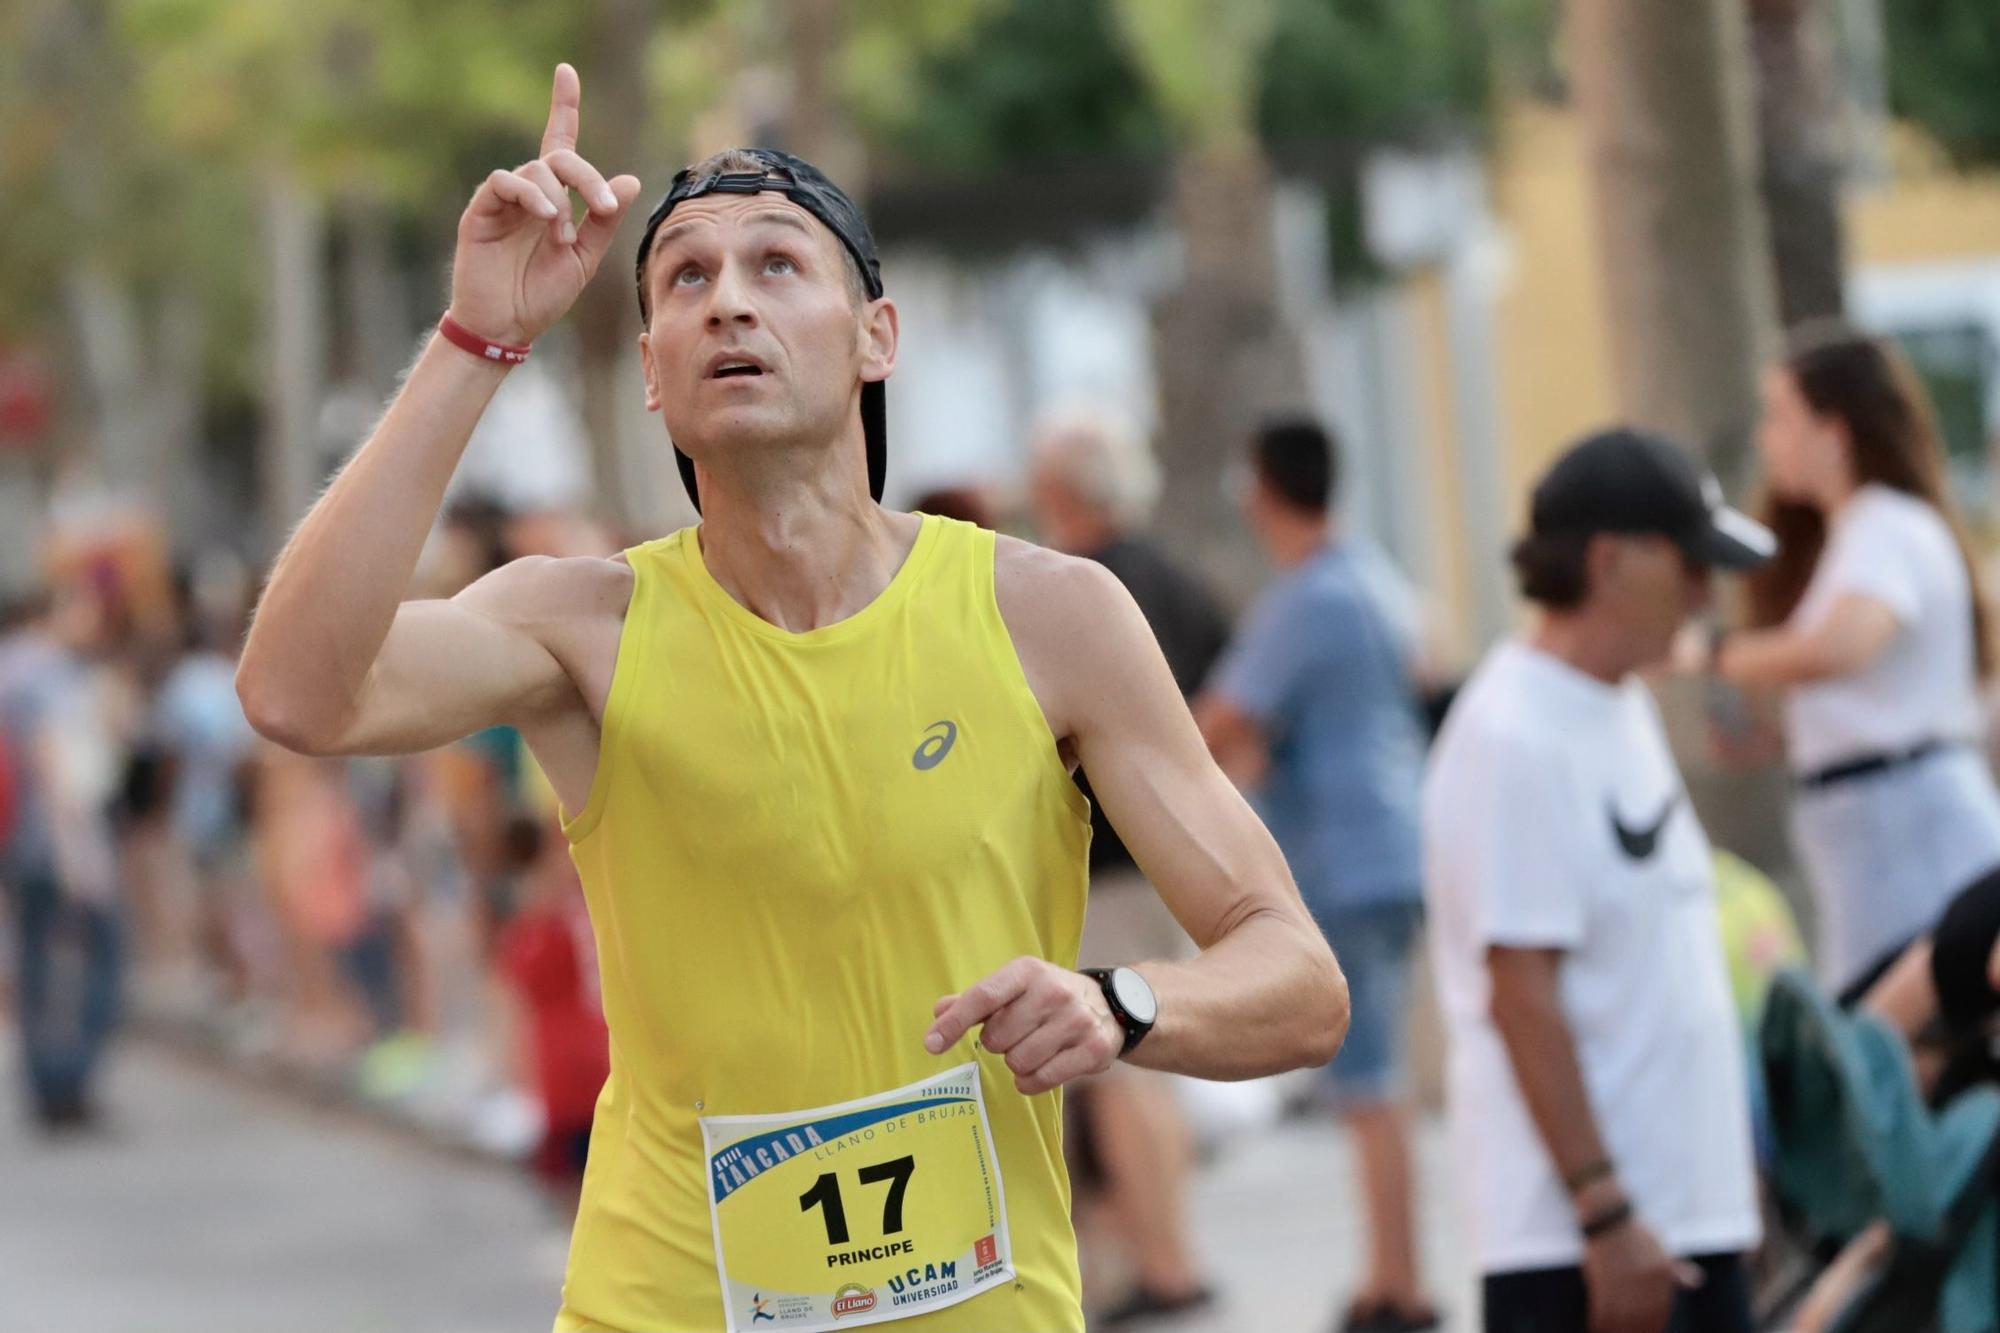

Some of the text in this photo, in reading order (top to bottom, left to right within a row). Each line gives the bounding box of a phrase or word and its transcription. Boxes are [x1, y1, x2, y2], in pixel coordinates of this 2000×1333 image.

[814, 1103, 976, 1161] LLANO DE BRUJAS
[714, 1147, 742, 1172] XVIII
[717, 1125, 824, 1194] ZANCADA
[799, 1154, 915, 1245] 17
[827, 1239, 914, 1268] PRINCIPE
[888, 1261, 956, 1294] UCAM
[893, 1280, 959, 1306] UNIVERSIDAD
[836, 1297, 873, 1312] El Llano
